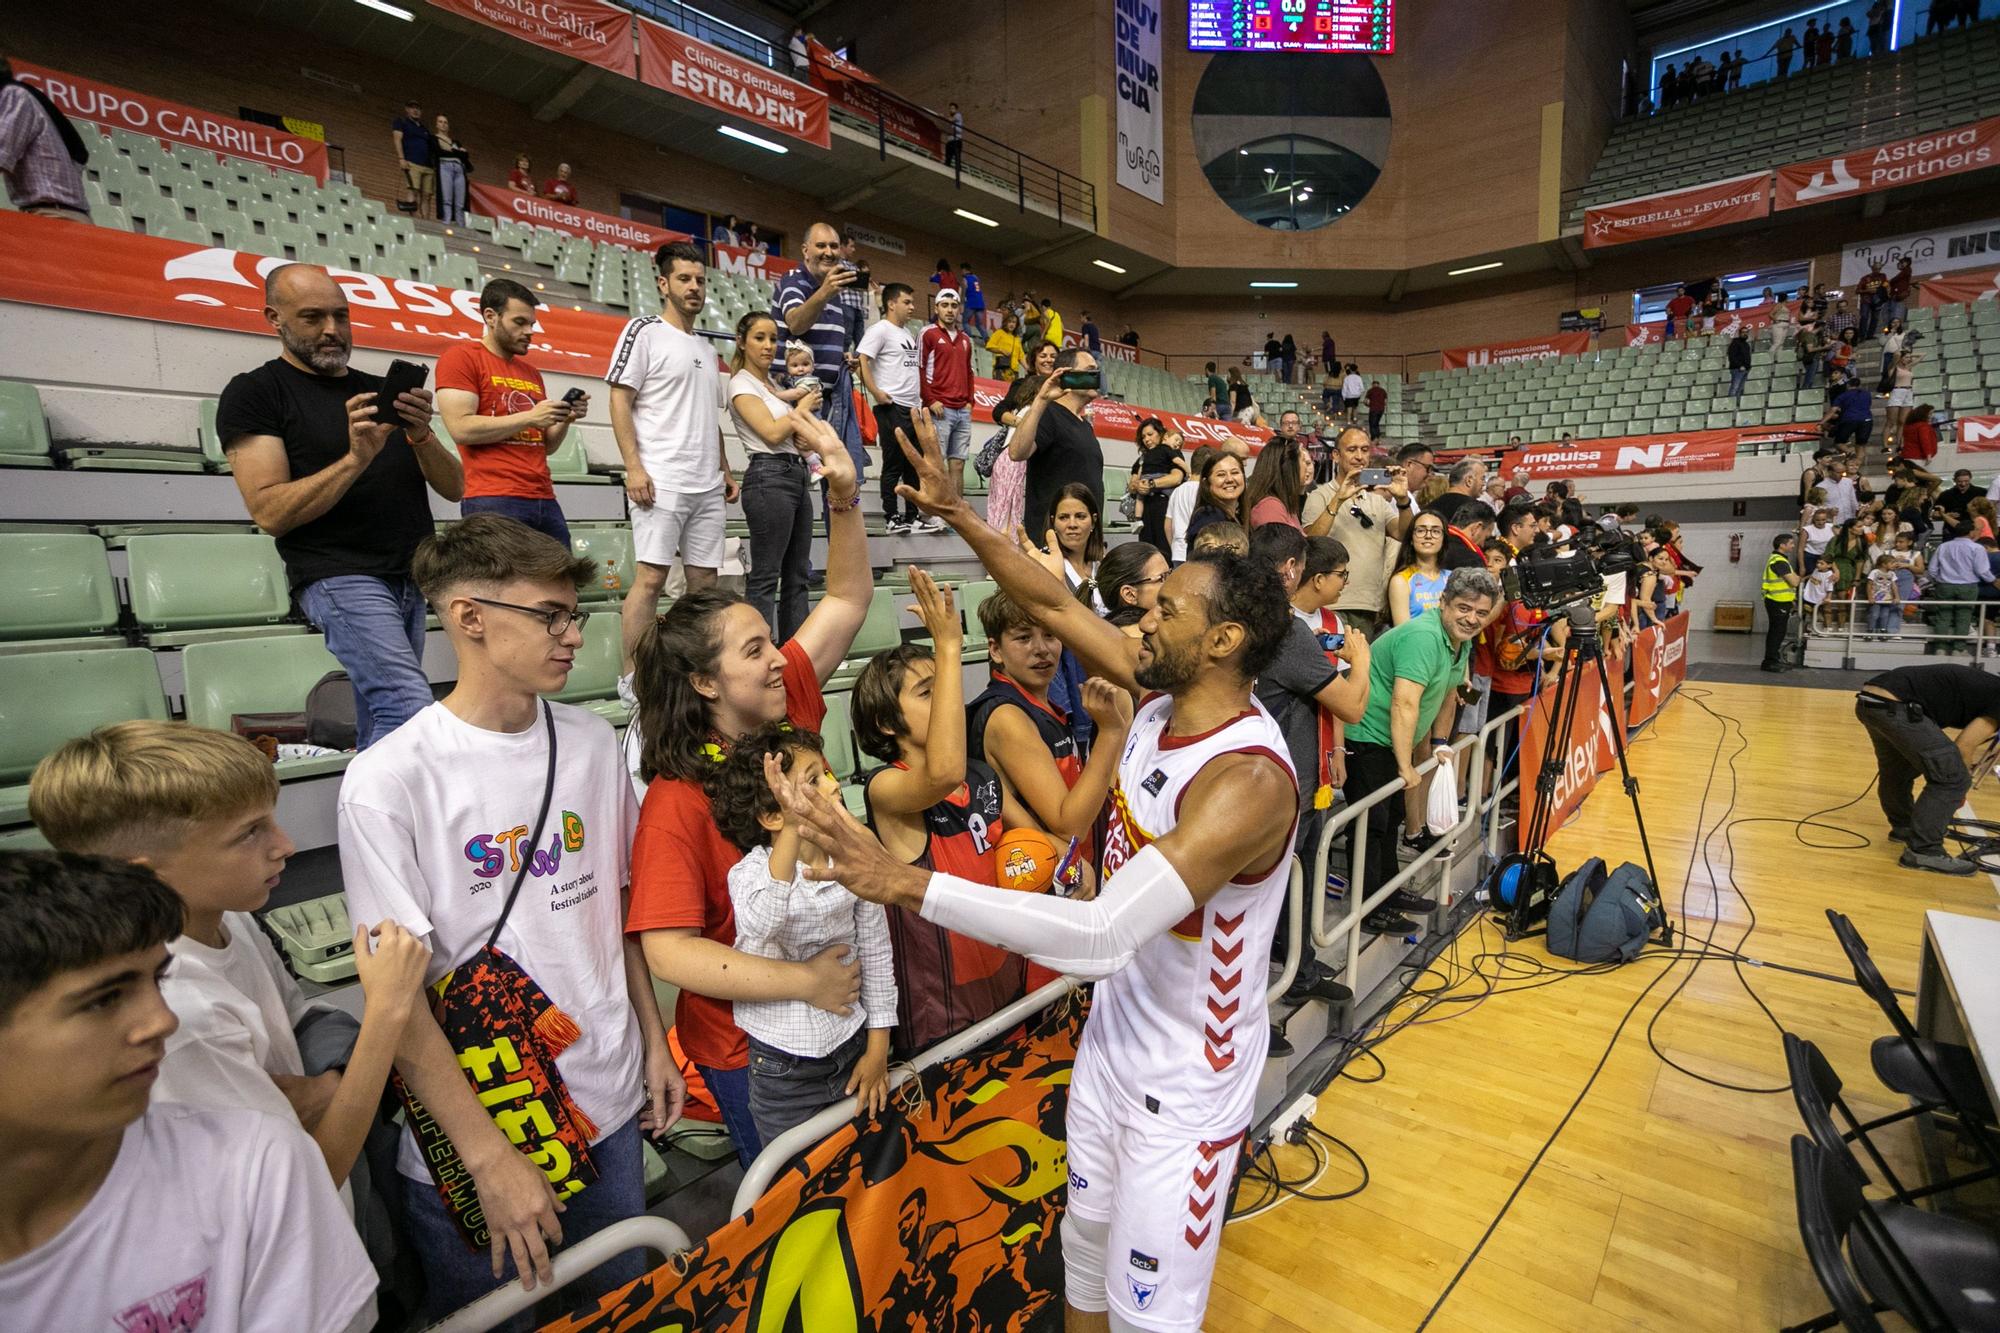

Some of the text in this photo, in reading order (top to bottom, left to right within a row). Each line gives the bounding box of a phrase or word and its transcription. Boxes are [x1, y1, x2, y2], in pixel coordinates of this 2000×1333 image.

[474, 2, 573, 48] Región de Murcia
[541, 4, 608, 45] Cálida
[1116, 0, 1158, 35] MUY
[1117, 12, 1140, 51] DE
[1289, 22, 1298, 32] 4
[684, 45, 796, 102] Clínicas dentales
[1117, 42, 1159, 92] MUR
[1118, 73, 1151, 114] CIA
[156, 110, 305, 164] CARRILLO
[1872, 128, 1977, 165] Asterra
[1870, 147, 1992, 186] Partners
[513, 197, 581, 228] Clínicas
[584, 212, 651, 244] dentales
[1613, 208, 1681, 228] ESTRELLA
[1695, 191, 1761, 213] LEVANTE
[1493, 343, 1550, 357] Construcciones
[1523, 442, 1689, 471] Impulsa N7
[1536, 463, 1599, 473] marca
[469, 881, 492, 896] 2020
[550, 884, 560, 896] A
[560, 878, 578, 893] story
[550, 892, 582, 912] festival
